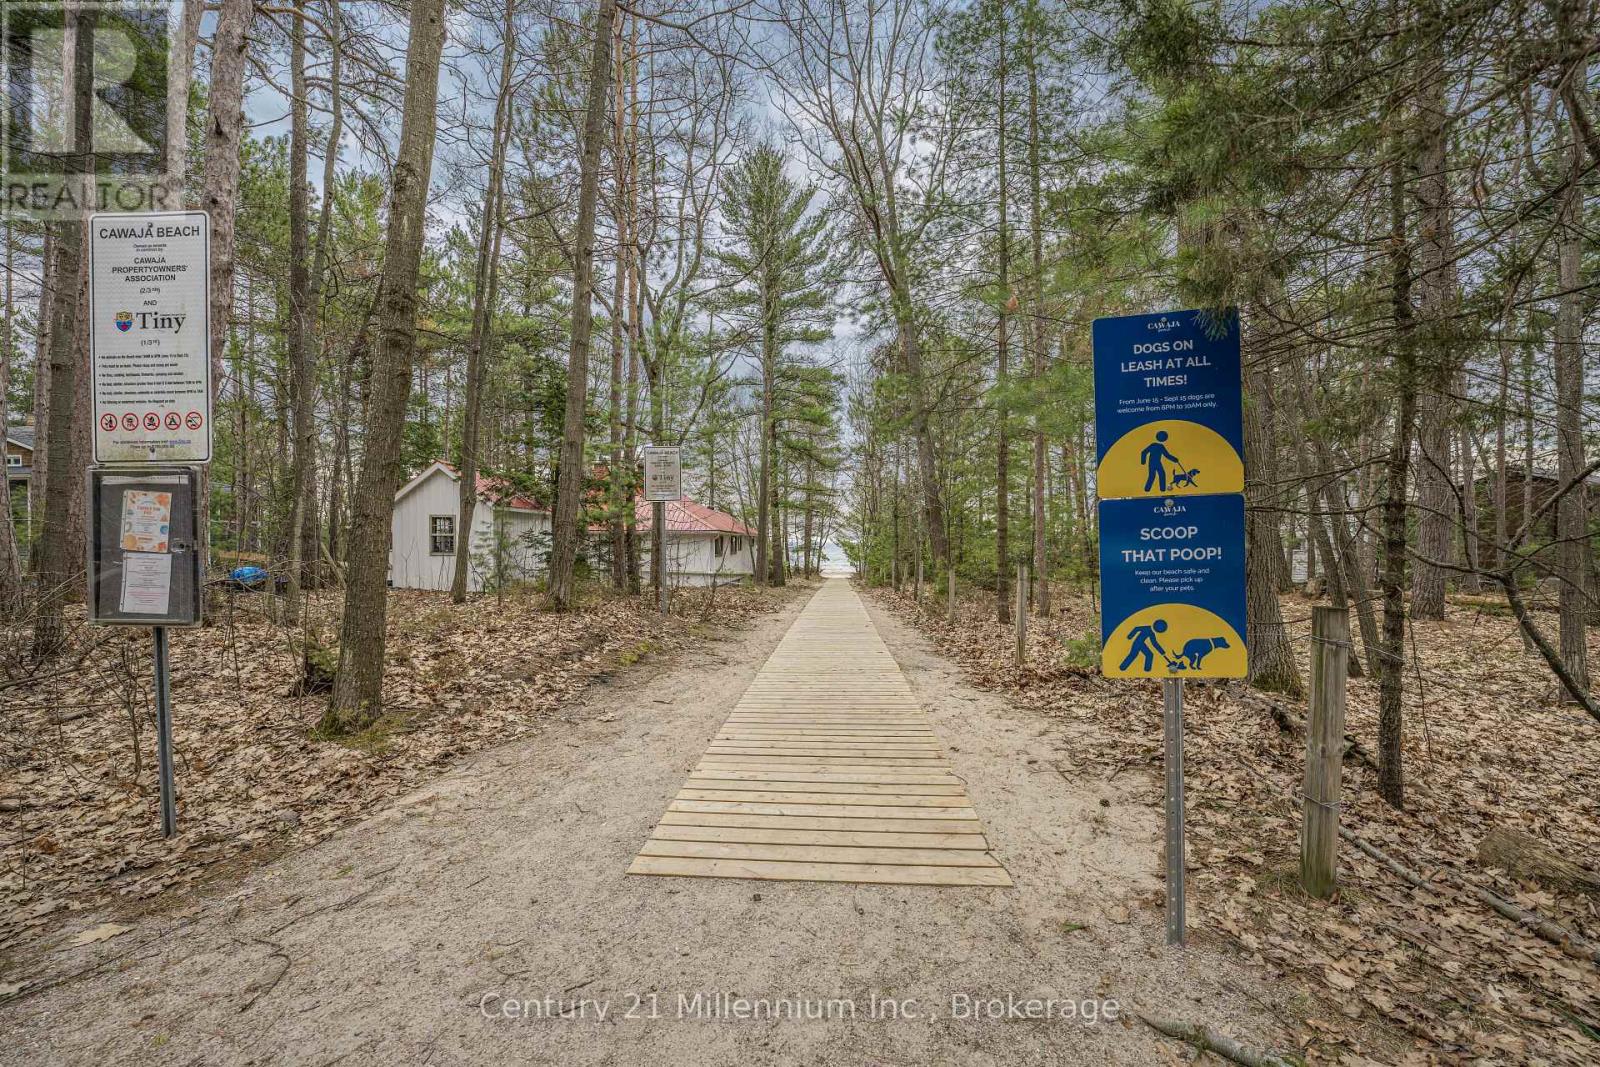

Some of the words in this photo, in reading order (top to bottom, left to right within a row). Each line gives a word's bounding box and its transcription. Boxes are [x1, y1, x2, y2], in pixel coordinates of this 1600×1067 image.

[99, 227, 153, 239] CAWAJA
[156, 226, 200, 238] BEACH
[134, 257, 166, 265] CAWAJA
[125, 274, 176, 282] ASSOCIATION
[136, 311, 187, 334] Tiny
[1147, 320, 1181, 330] CAWAJA
[1133, 341, 1171, 355] DOGS
[1172, 339, 1194, 351] ON
[1121, 359, 1163, 373] LEASH
[1165, 357, 1183, 369] AT
[1185, 355, 1212, 368] ALL
[1144, 374, 1188, 388] TIMES!
[1136, 397, 1151, 405] June
[1187, 394, 1203, 402] dogs
[1117, 406, 1145, 414] welcome
[1153, 505, 1187, 514] CAWAJA
[1140, 526, 1198, 541] SCOOP
[1121, 548, 1166, 563] THAT
[1170, 547, 1222, 561] POOP!
[1180, 576, 1194, 584] pick
